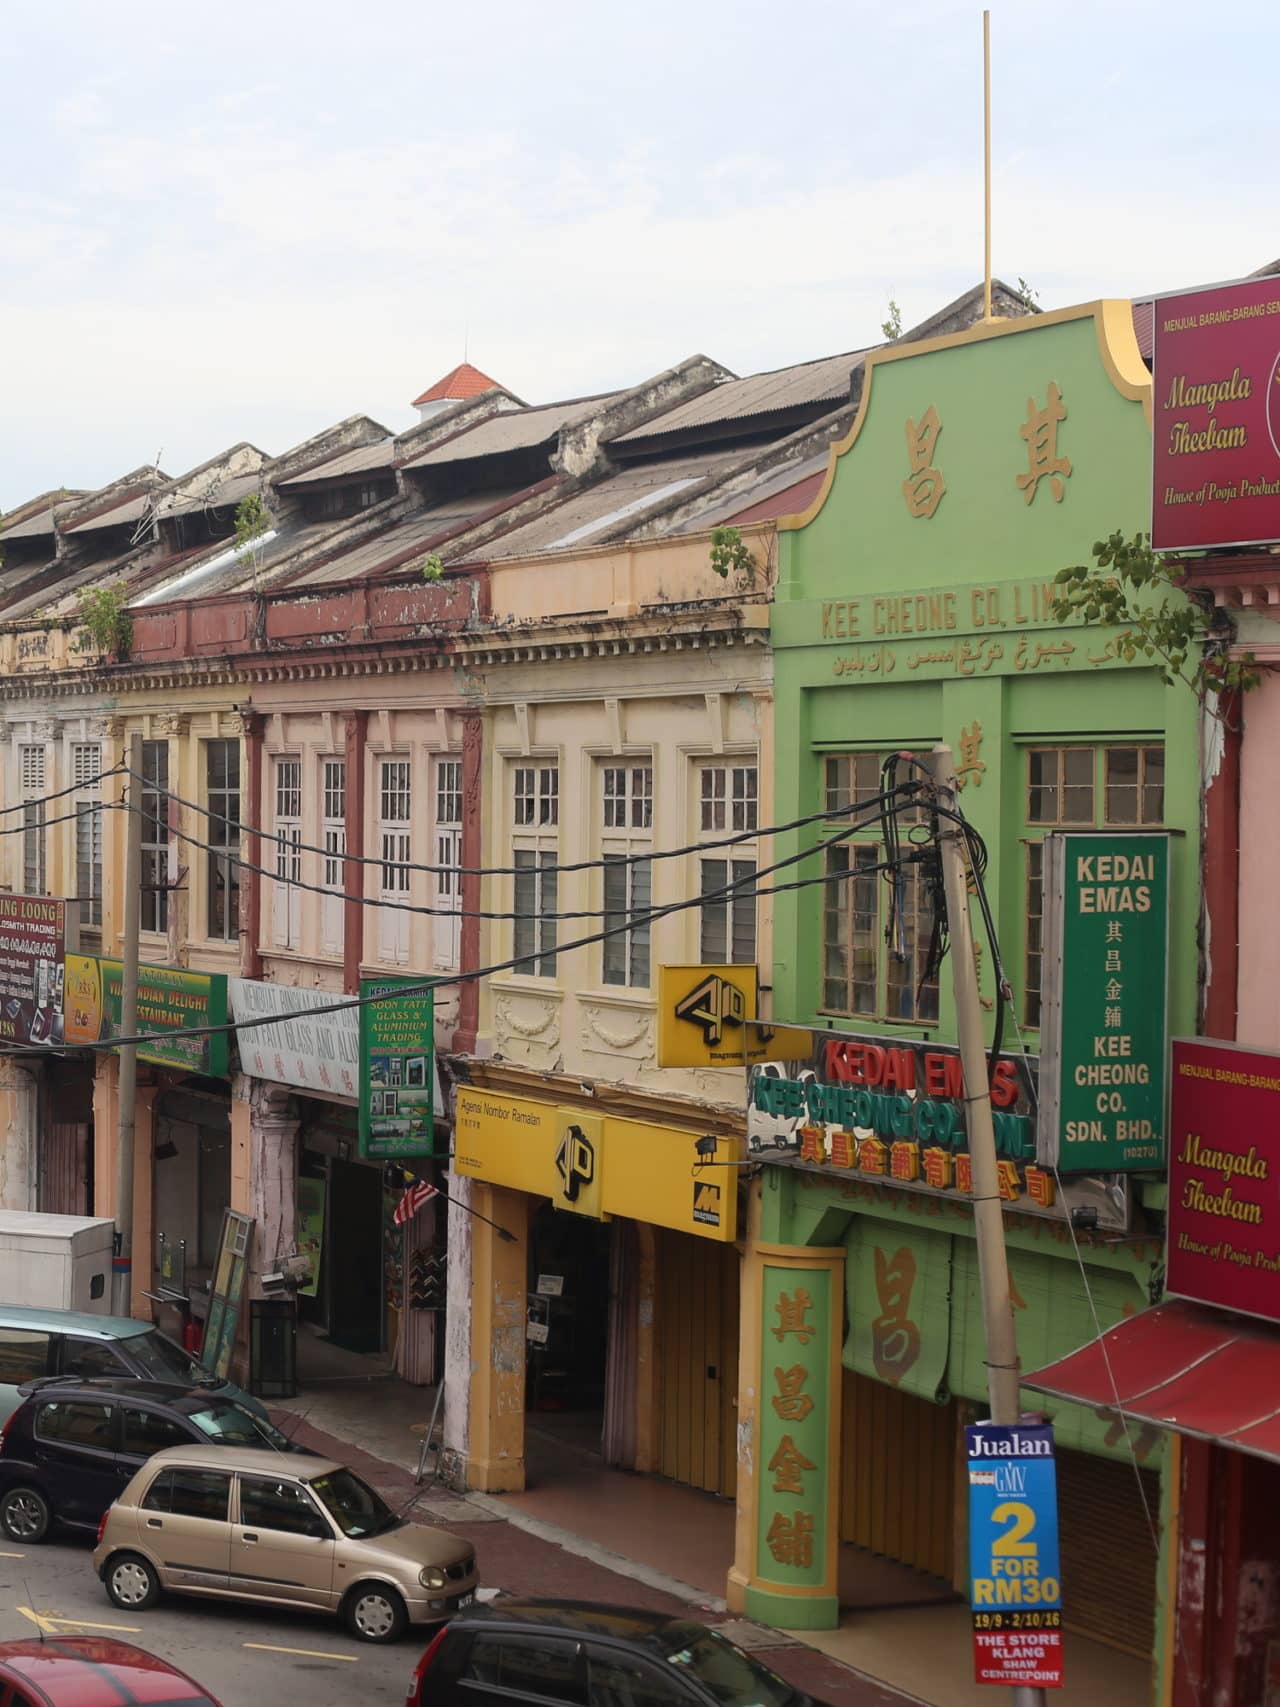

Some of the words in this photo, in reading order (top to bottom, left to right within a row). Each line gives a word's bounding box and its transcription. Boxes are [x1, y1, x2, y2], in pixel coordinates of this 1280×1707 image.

[1164, 315, 1198, 332] MENJUAL
[1164, 367, 1251, 414] Mangala
[1168, 418, 1247, 455] Theebam
[1164, 486, 1194, 505] House
[1195, 481, 1207, 506] of
[1208, 480, 1237, 504] Pooja
[822, 600, 861, 639] KEE
[871, 591, 957, 635] CHEONG
[1077, 854, 1154, 882] KEDAI
[21, 901, 56, 922] LOONG
[1079, 886, 1151, 914] EMAS
[26, 922, 56, 936] TRADING
[168, 990, 209, 1013] DELIGHT
[371, 1021, 427, 1032] ALUMINIUM
[376, 1011, 409, 1020] GLASS
[1094, 1035, 1132, 1057] KEE
[826, 1039, 917, 1091] KEDAI
[925, 1052, 1020, 1107] EMS
[1074, 1064, 1149, 1086] CHEONG
[1179, 1063, 1214, 1081] MENJUAL
[461, 1098, 481, 1114] Agensi
[483, 1103, 510, 1120] Nombor
[511, 1107, 541, 1126] Ramalan
[755, 1076, 806, 1117] KEE
[808, 1083, 914, 1138] CHEONG
[916, 1100, 966, 1146] CO.
[1096, 1092, 1127, 1113] CO.
[1065, 1121, 1107, 1142] SDN.
[1177, 1133, 1269, 1182] Mangala
[1182, 1178, 1263, 1225] Theebam
[1178, 1231, 1209, 1256] House
[1210, 1240, 1223, 1263] of
[1223, 1243, 1252, 1267] Pooja
[969, 1433, 1052, 1457] Jualan
[995, 1462, 1027, 1493] GMV
[990, 1502, 1038, 1557] 2
[991, 1559, 1039, 1577] FOR
[974, 1577, 1061, 1605] RM30
[975, 1613, 1002, 1630] 19/9
[1012, 1611, 1060, 1629] 2/10/16
[976, 1635, 1005, 1647] THE
[1008, 1633, 1060, 1646] STORE
[992, 1647, 1045, 1659] KLANG
[1002, 1659, 1037, 1669] SHAW
[981, 1669, 1060, 1681] CENTREPOINT
